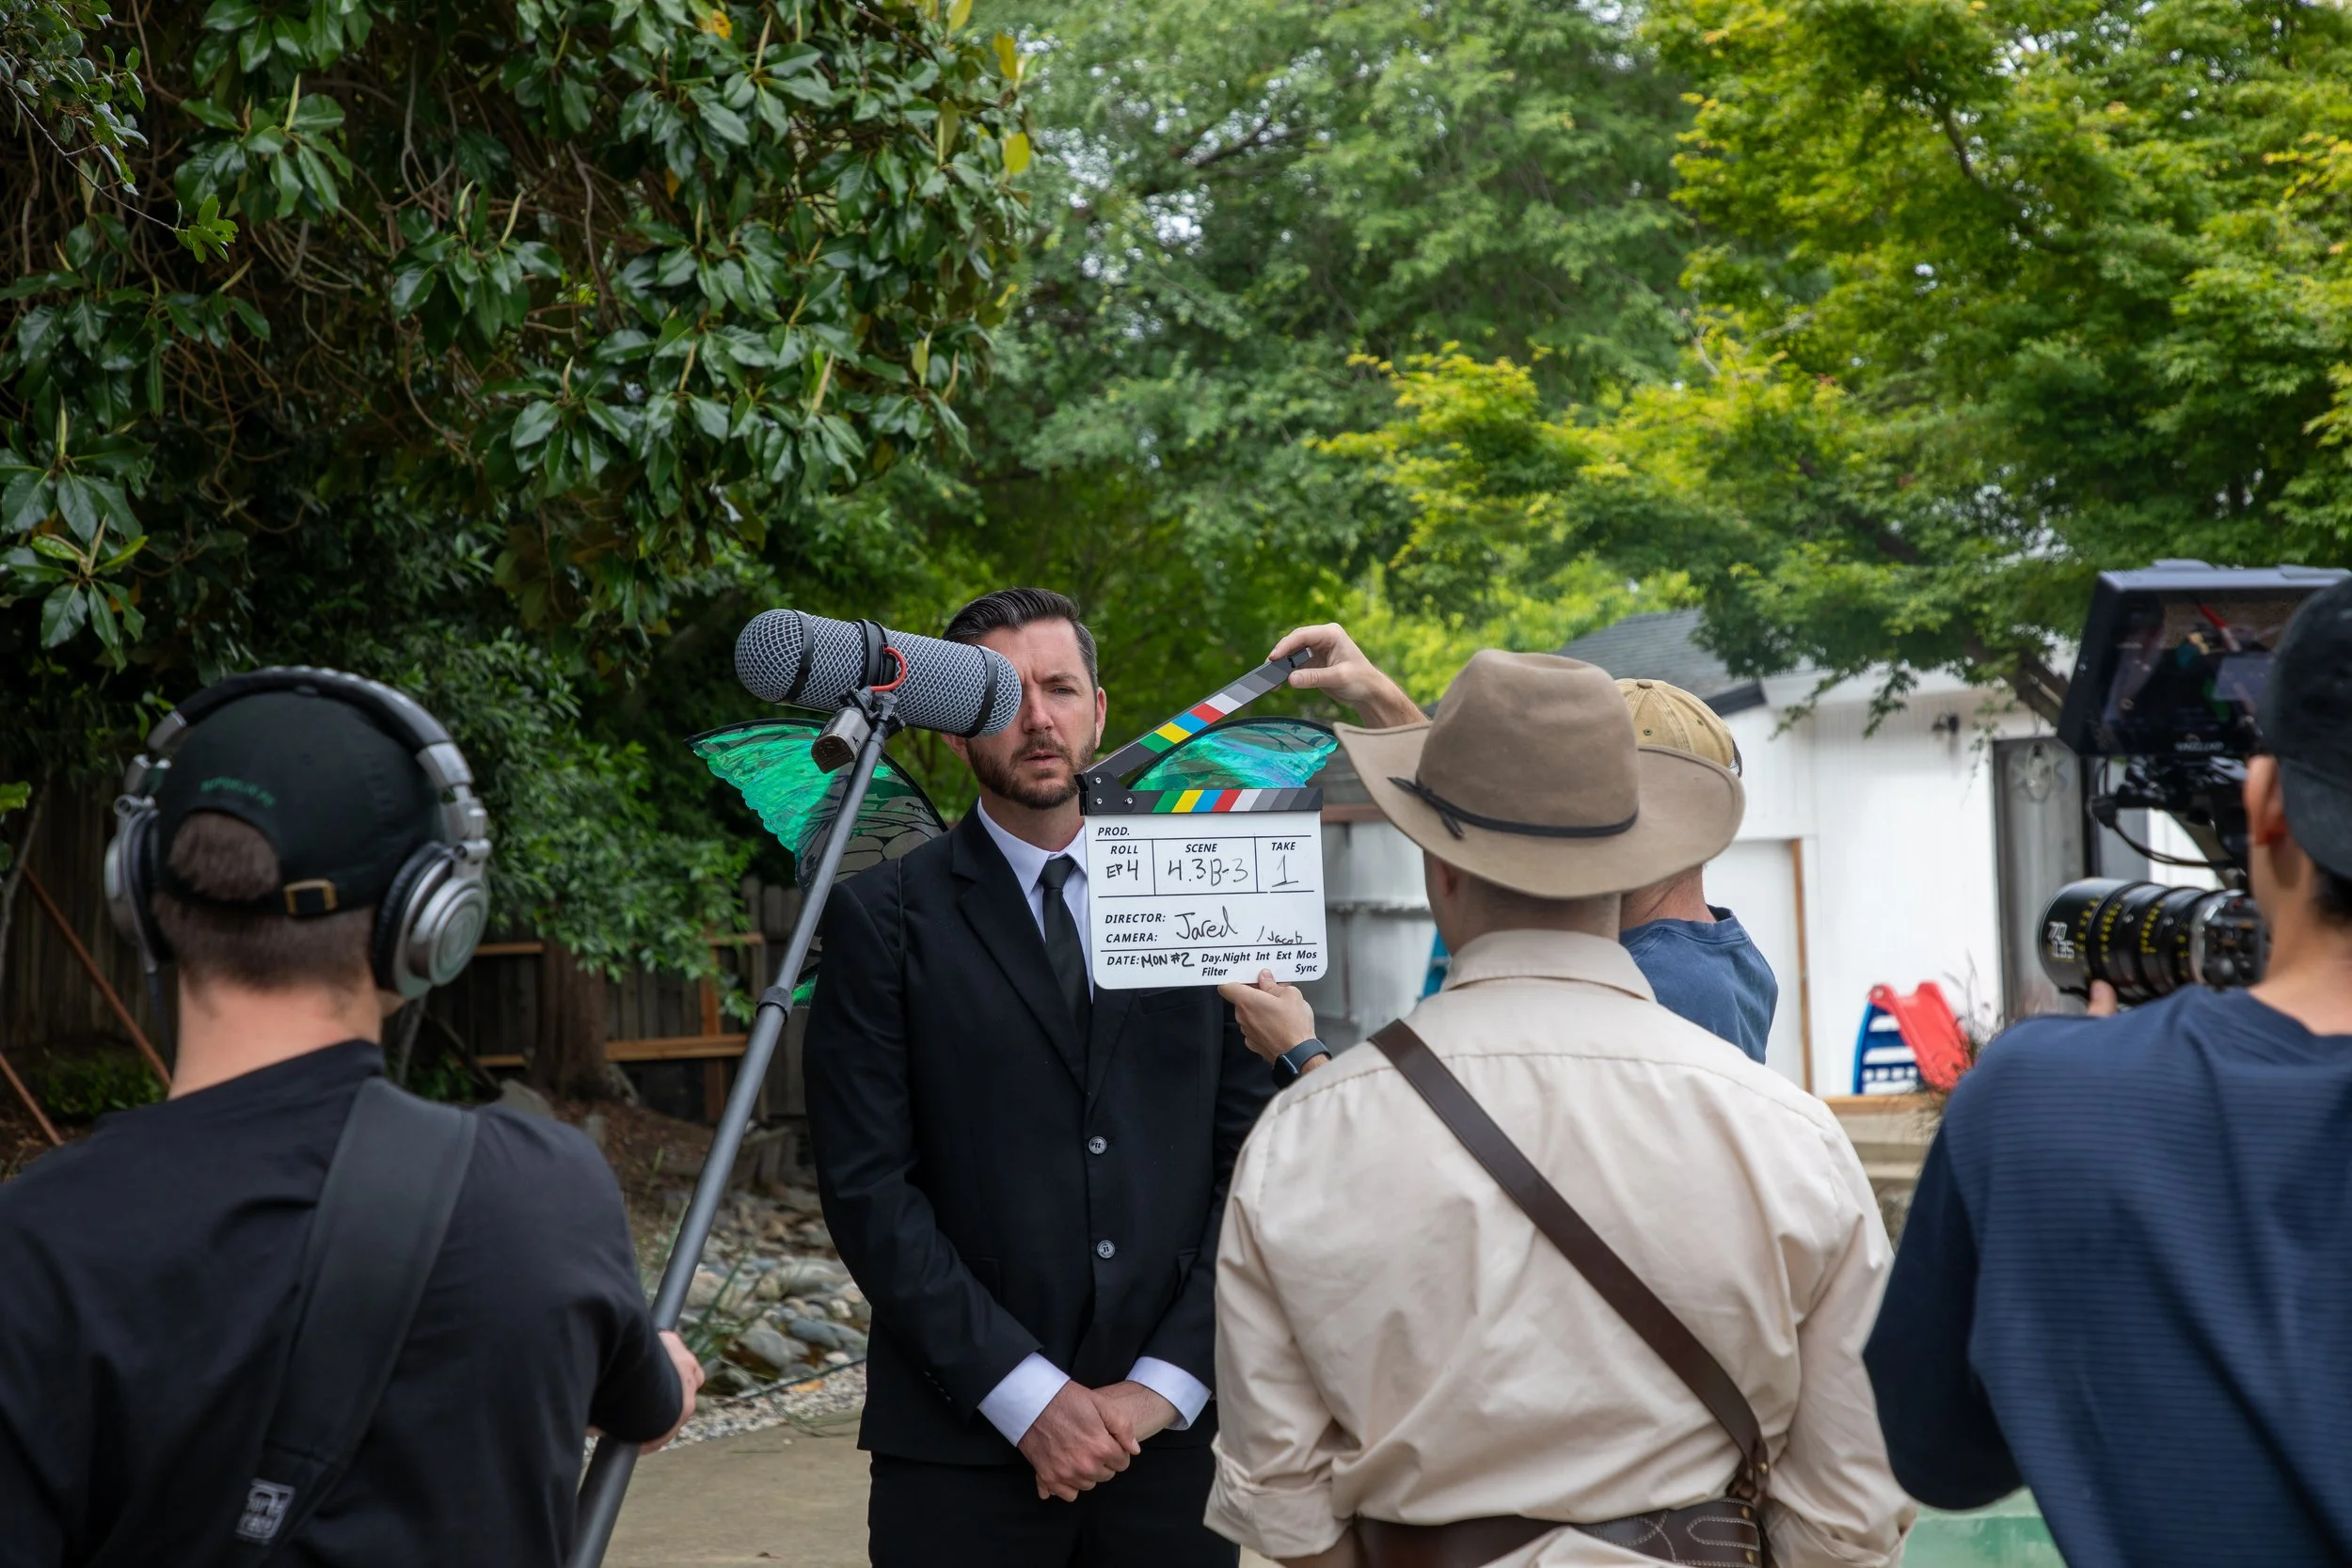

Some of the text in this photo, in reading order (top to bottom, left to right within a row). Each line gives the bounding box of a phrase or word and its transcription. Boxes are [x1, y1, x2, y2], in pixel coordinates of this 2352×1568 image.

[1097, 827, 1130, 836] PROD.
[1110, 845, 1138, 855] ROLL
[1185, 843, 1217, 853] SCENE
[1271, 841, 1296, 851] TAKE
[1272, 854, 1298, 887] 1
[1104, 913, 1167, 925] DIRECTOR:
[1174, 905, 1238, 941] Jared
[1105, 933, 1158, 943] CAMERA:
[1256, 951, 1270, 961] Int
[1276, 950, 1292, 960] Ext
[1296, 950, 1317, 959] Mos
[1106, 956, 1140, 966] DATE:
[1202, 966, 1228, 977] Filter
[1295, 963, 1318, 974] Sync
